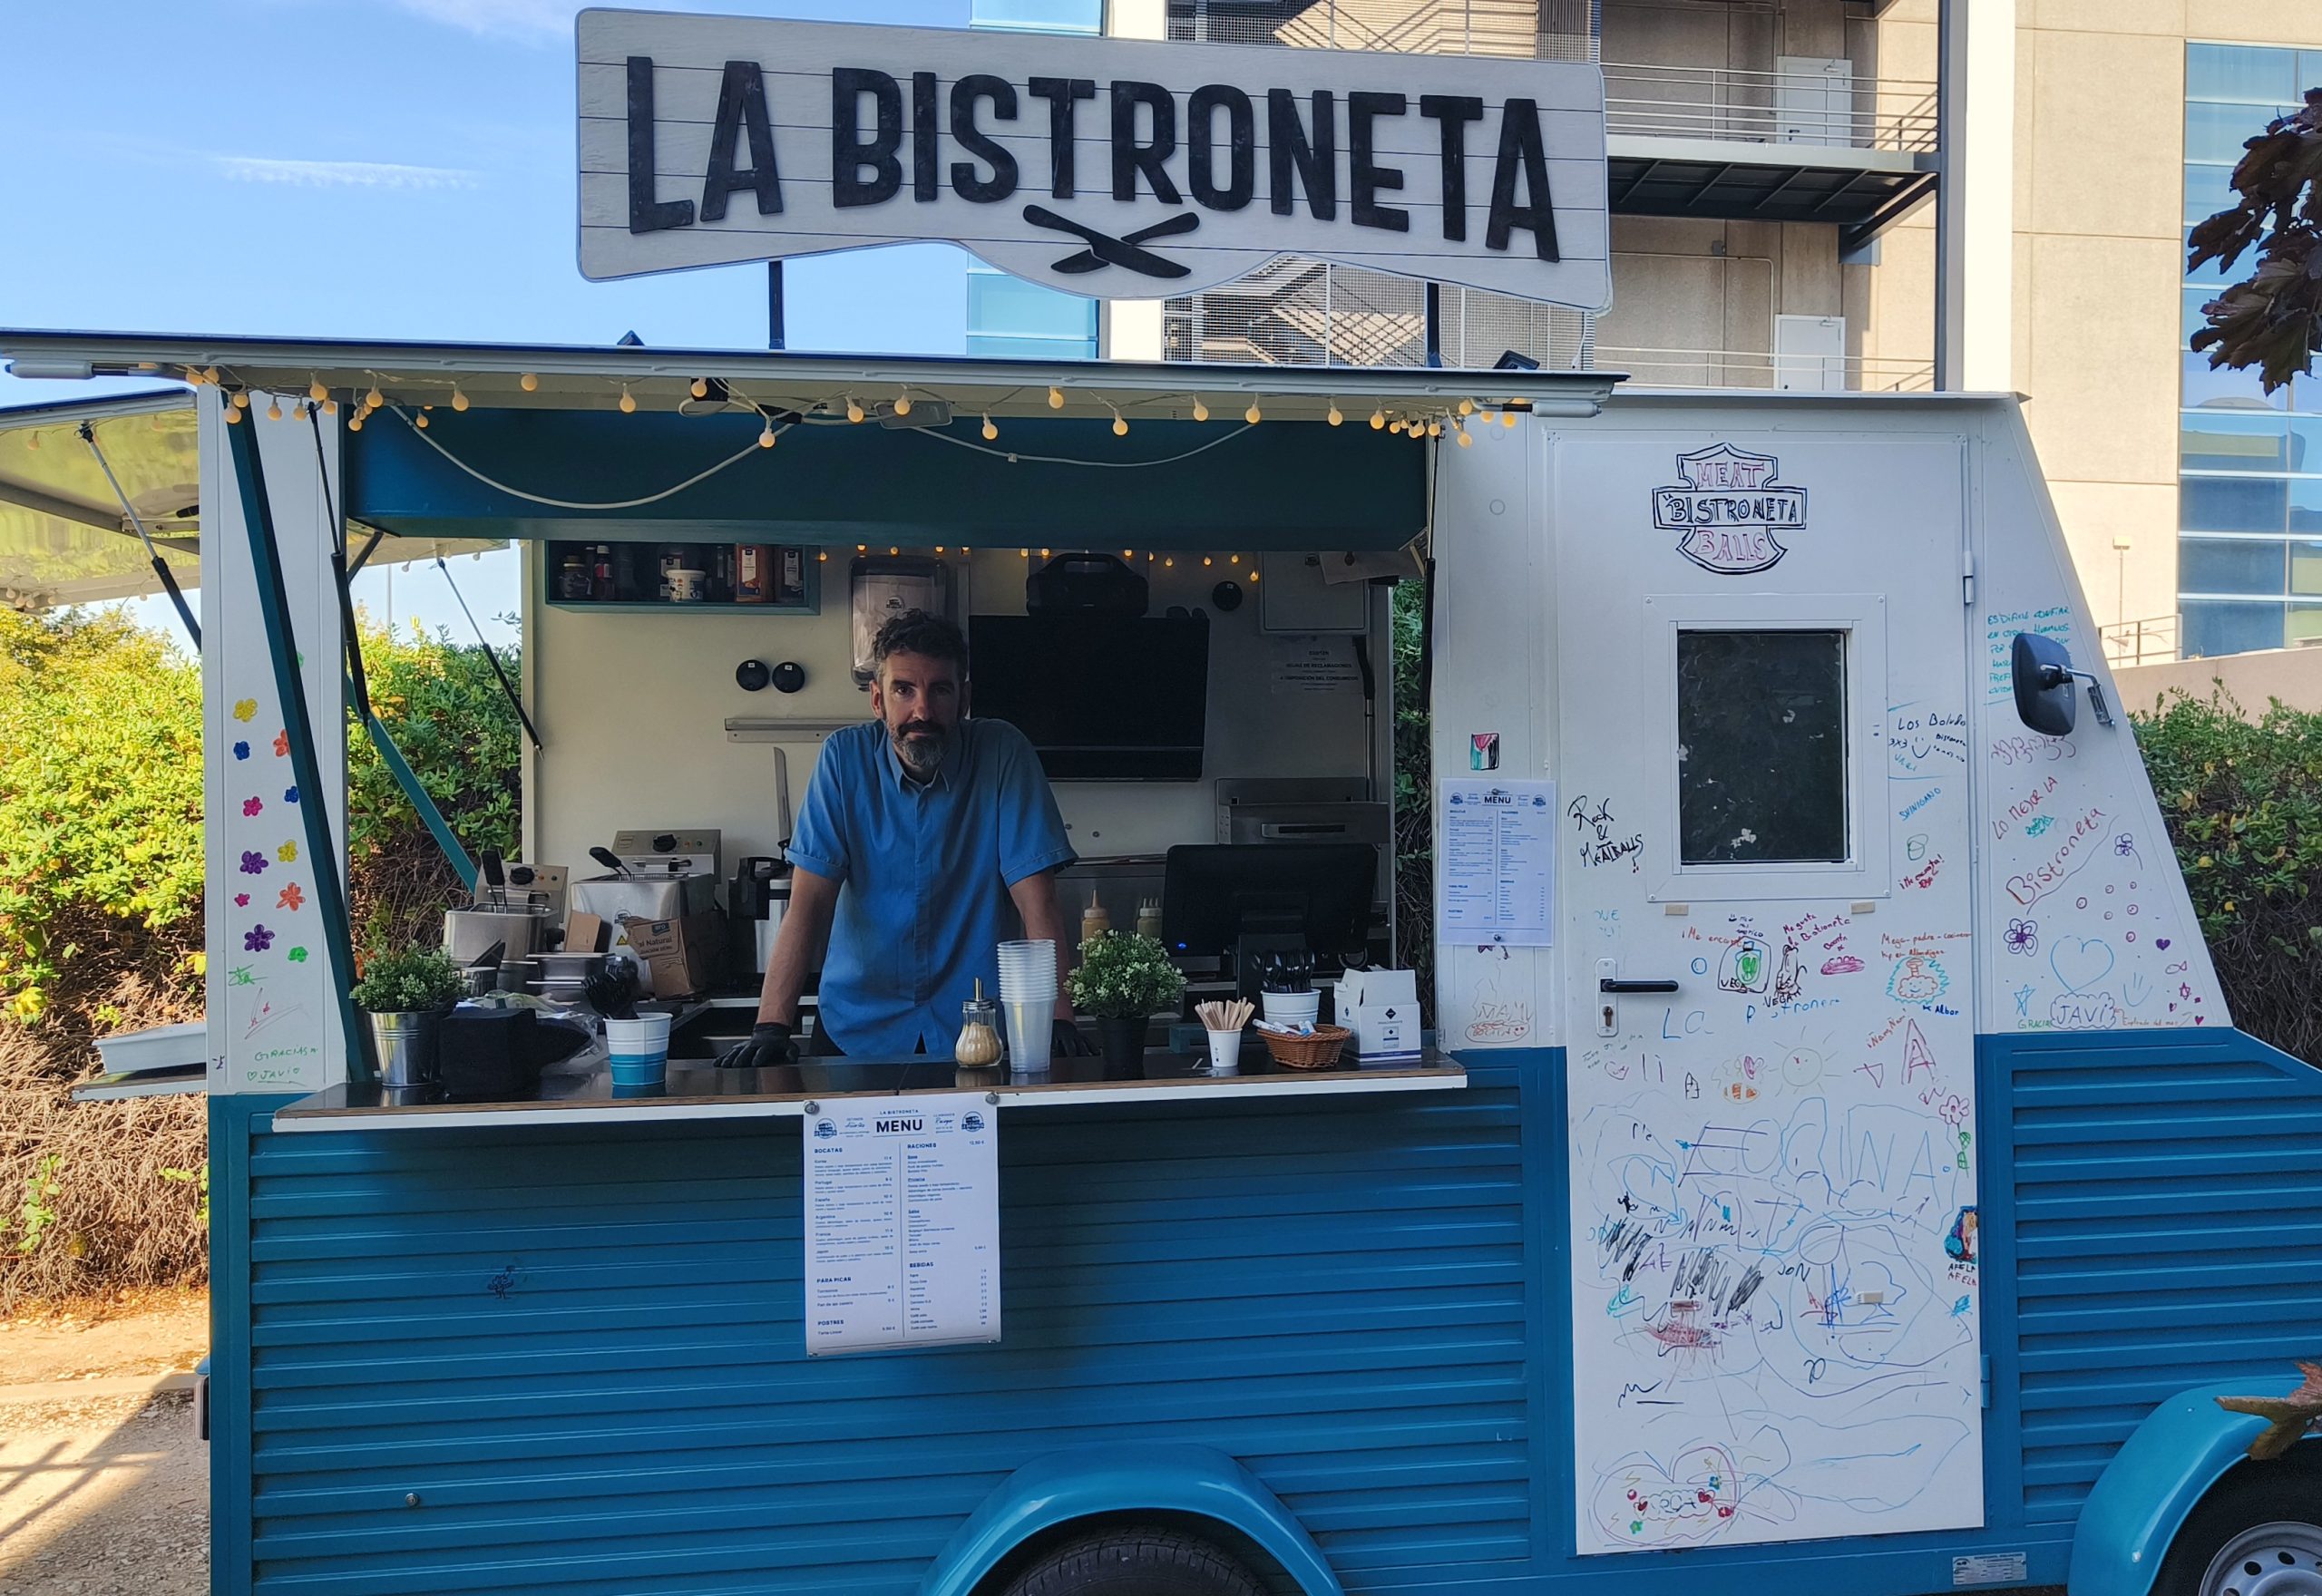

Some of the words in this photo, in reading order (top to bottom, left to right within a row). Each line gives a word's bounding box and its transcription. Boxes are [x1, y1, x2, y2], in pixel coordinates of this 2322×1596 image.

[627, 56, 784, 235] LA
[832, 66, 1561, 263] BISTRONETA
[1695, 462, 1765, 489] MEAT
[1665, 497, 1798, 524] BISTRONETA
[1693, 530, 1768, 561] BALLS
[1484, 796, 1512, 804] MENU
[646, 935, 672, 947] Natural
[876, 1119, 922, 1134] MENU
